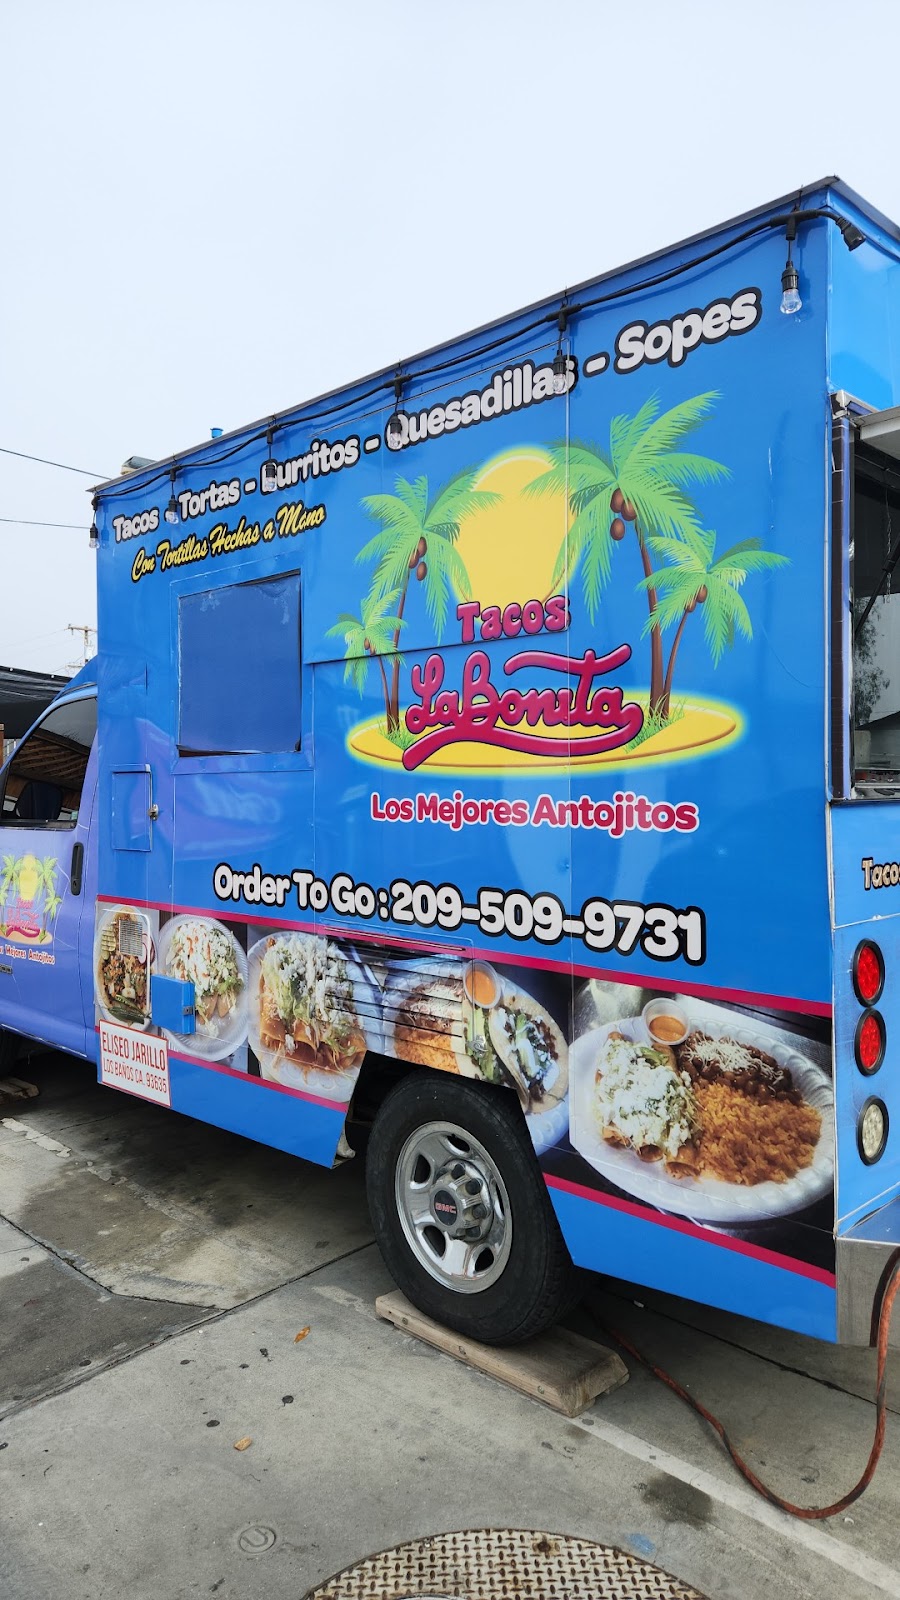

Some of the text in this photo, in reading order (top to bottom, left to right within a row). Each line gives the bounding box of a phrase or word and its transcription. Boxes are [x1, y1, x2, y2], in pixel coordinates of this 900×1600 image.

[113, 508, 160, 542] Tacos
[178, 478, 242, 521] Tortas
[614, 287, 762, 374] Sopes
[131, 502, 327, 583] Con Tortillas Hechas a Mano
[457, 594, 571, 643] Tacos
[405, 653, 461, 734] La
[371, 789, 701, 839] Los Mejores Antojitos
[861, 856, 900, 891] Taco
[212, 863, 291, 905] Order
[291, 868, 328, 912] To
[388, 878, 707, 967] 209-509-9731
[102, 1032, 166, 1071] ELISEO JARILLO
[103, 1058, 113, 1074] LOS
[146, 1073, 167, 1093] 93635
[435, 1202, 457, 1214] GMC
